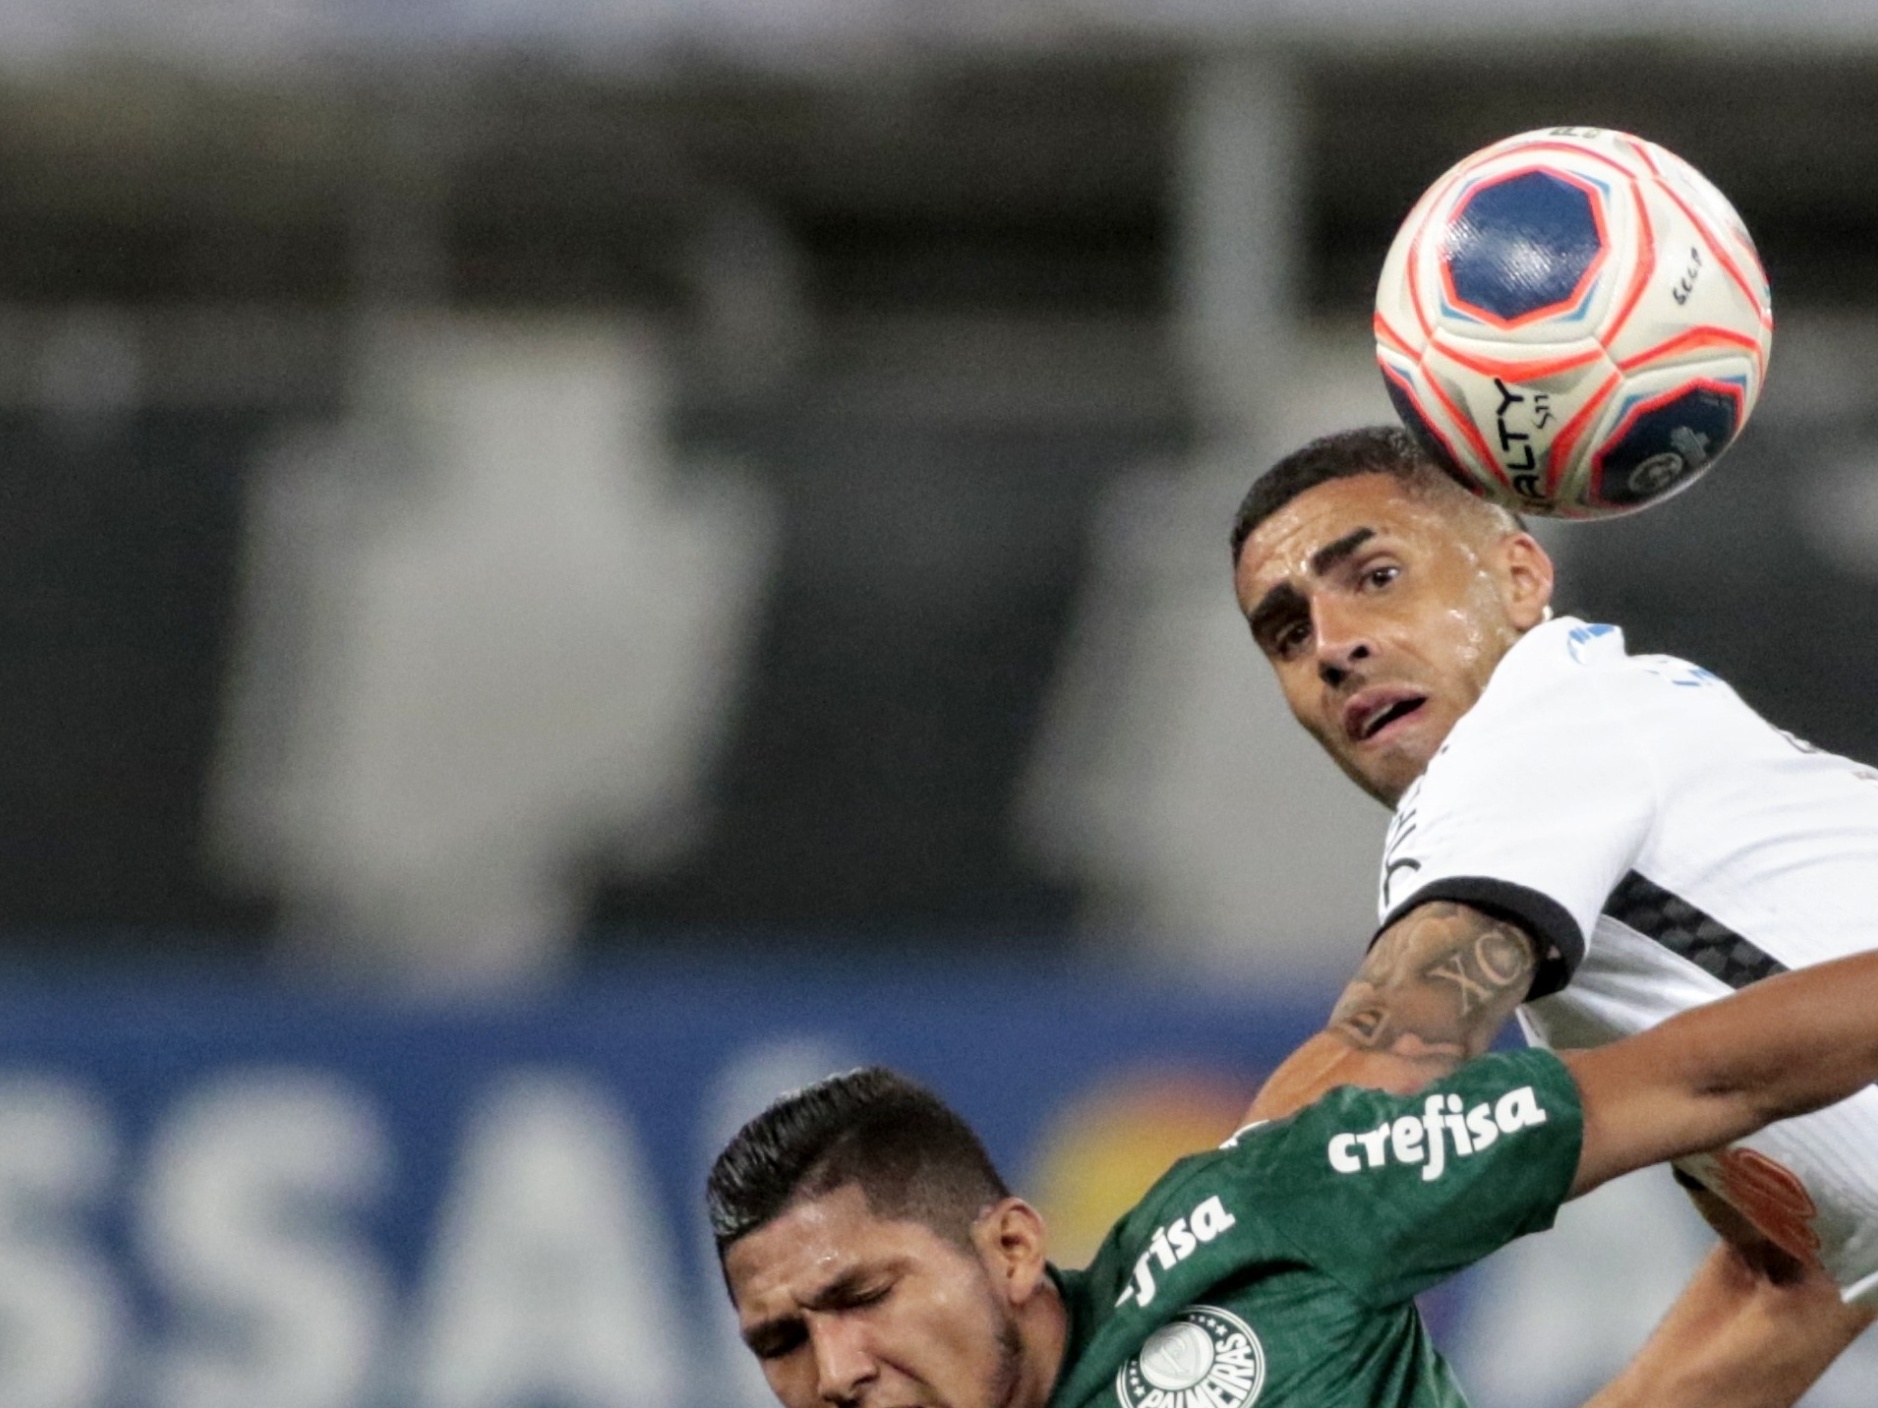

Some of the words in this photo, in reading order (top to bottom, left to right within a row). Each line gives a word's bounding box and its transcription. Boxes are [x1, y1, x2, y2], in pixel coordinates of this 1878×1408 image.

[1494, 377, 1555, 510] ALTY
[1327, 1086, 1547, 1183] crefisa
[1114, 1195, 1236, 1307] fisa
